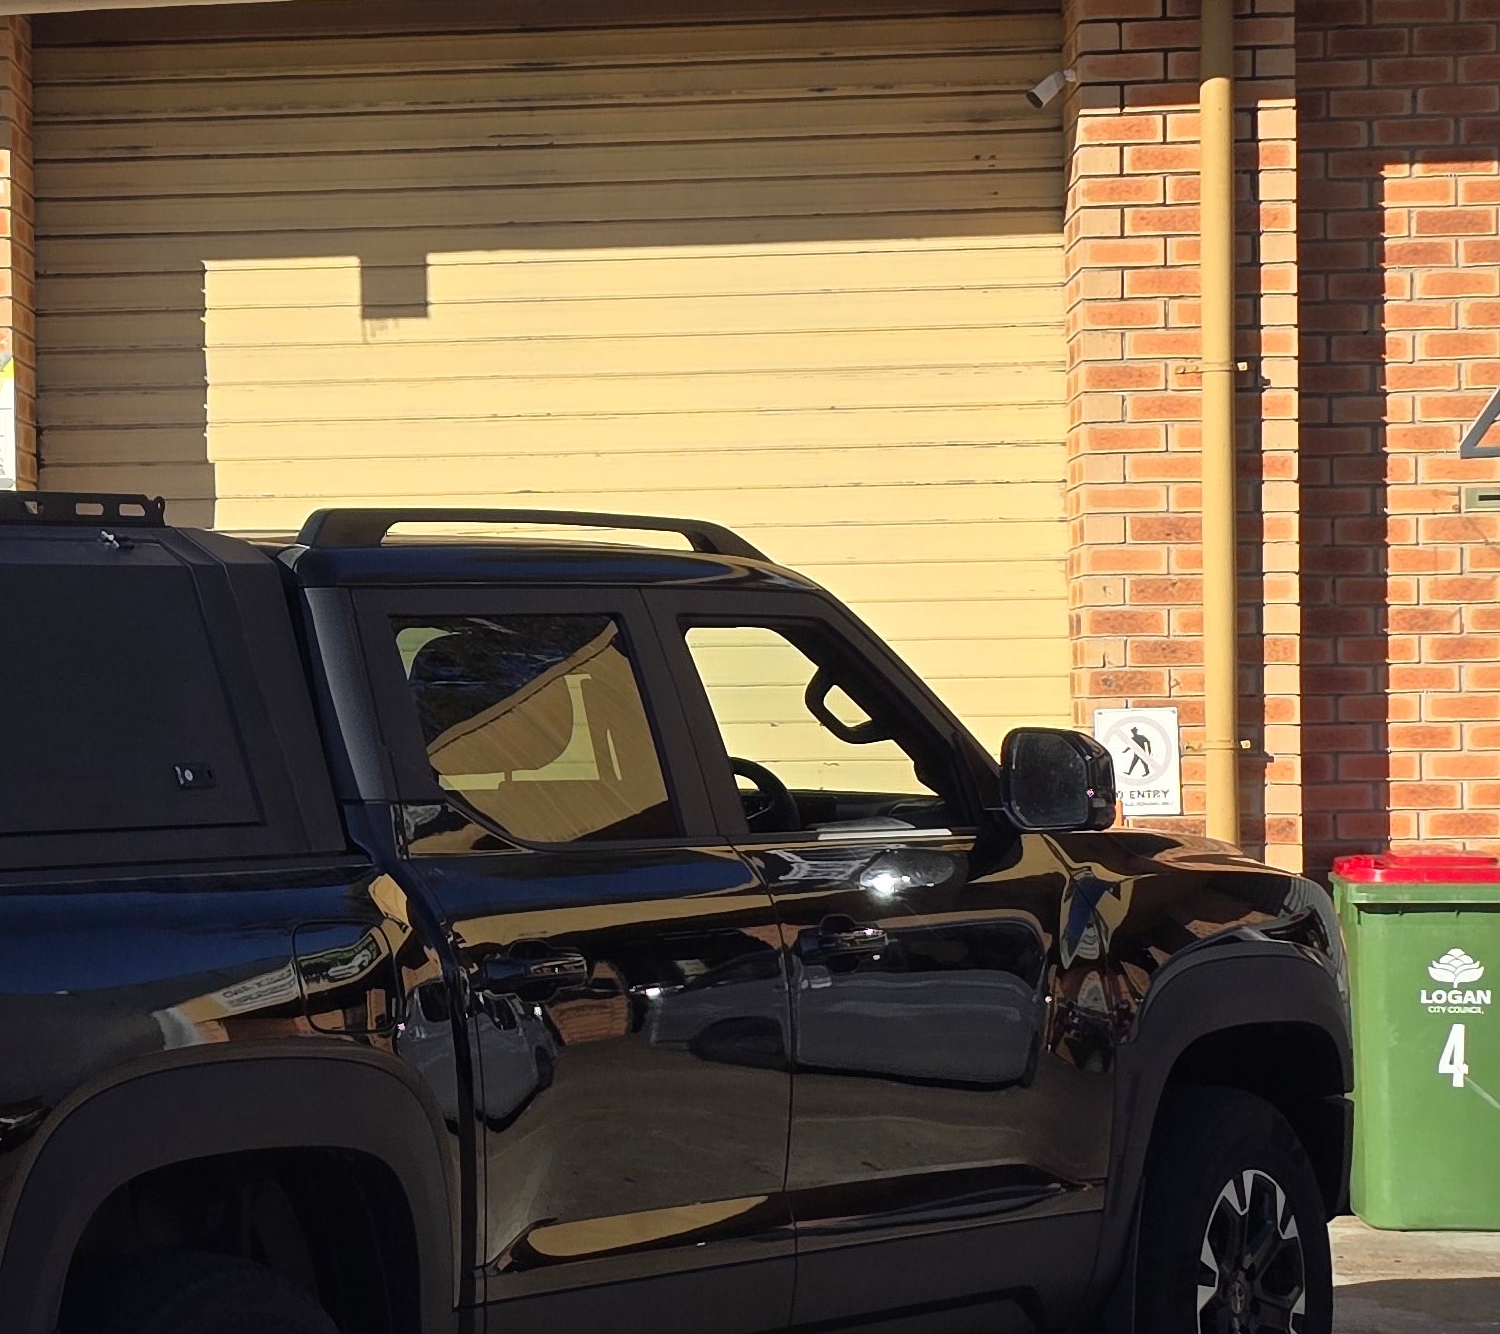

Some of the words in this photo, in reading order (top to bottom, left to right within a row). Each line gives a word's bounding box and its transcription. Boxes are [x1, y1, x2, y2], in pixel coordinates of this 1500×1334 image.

[1129, 789, 1169, 799] ENTRY
[1420, 989, 1492, 1005] LOGAN
[1438, 1023, 1469, 1088] 4
